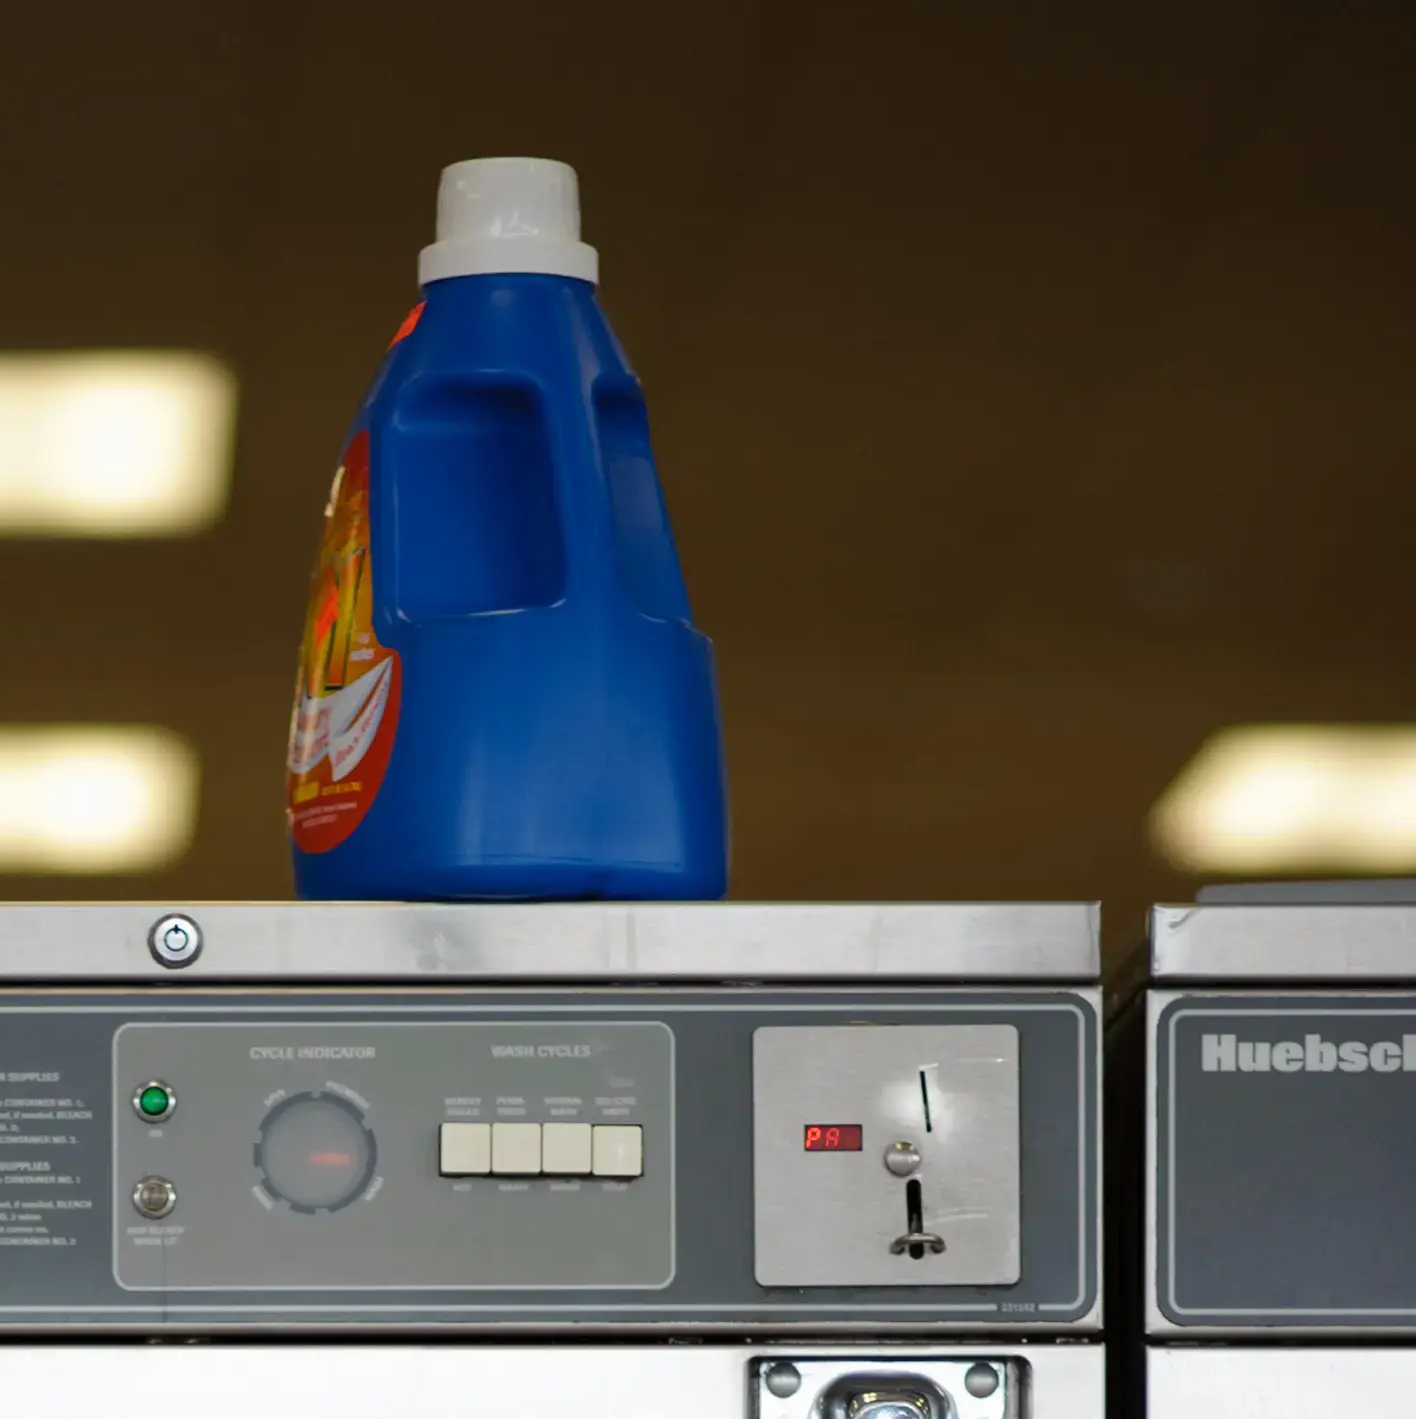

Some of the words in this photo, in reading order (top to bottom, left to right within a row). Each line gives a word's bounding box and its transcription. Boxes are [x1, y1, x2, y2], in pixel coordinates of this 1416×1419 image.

[250, 1047, 293, 1060] CYCLE
[298, 1047, 375, 1060] INDICATOR
[492, 1045, 534, 1058] WASH
[538, 1045, 590, 1058] CYCLES
